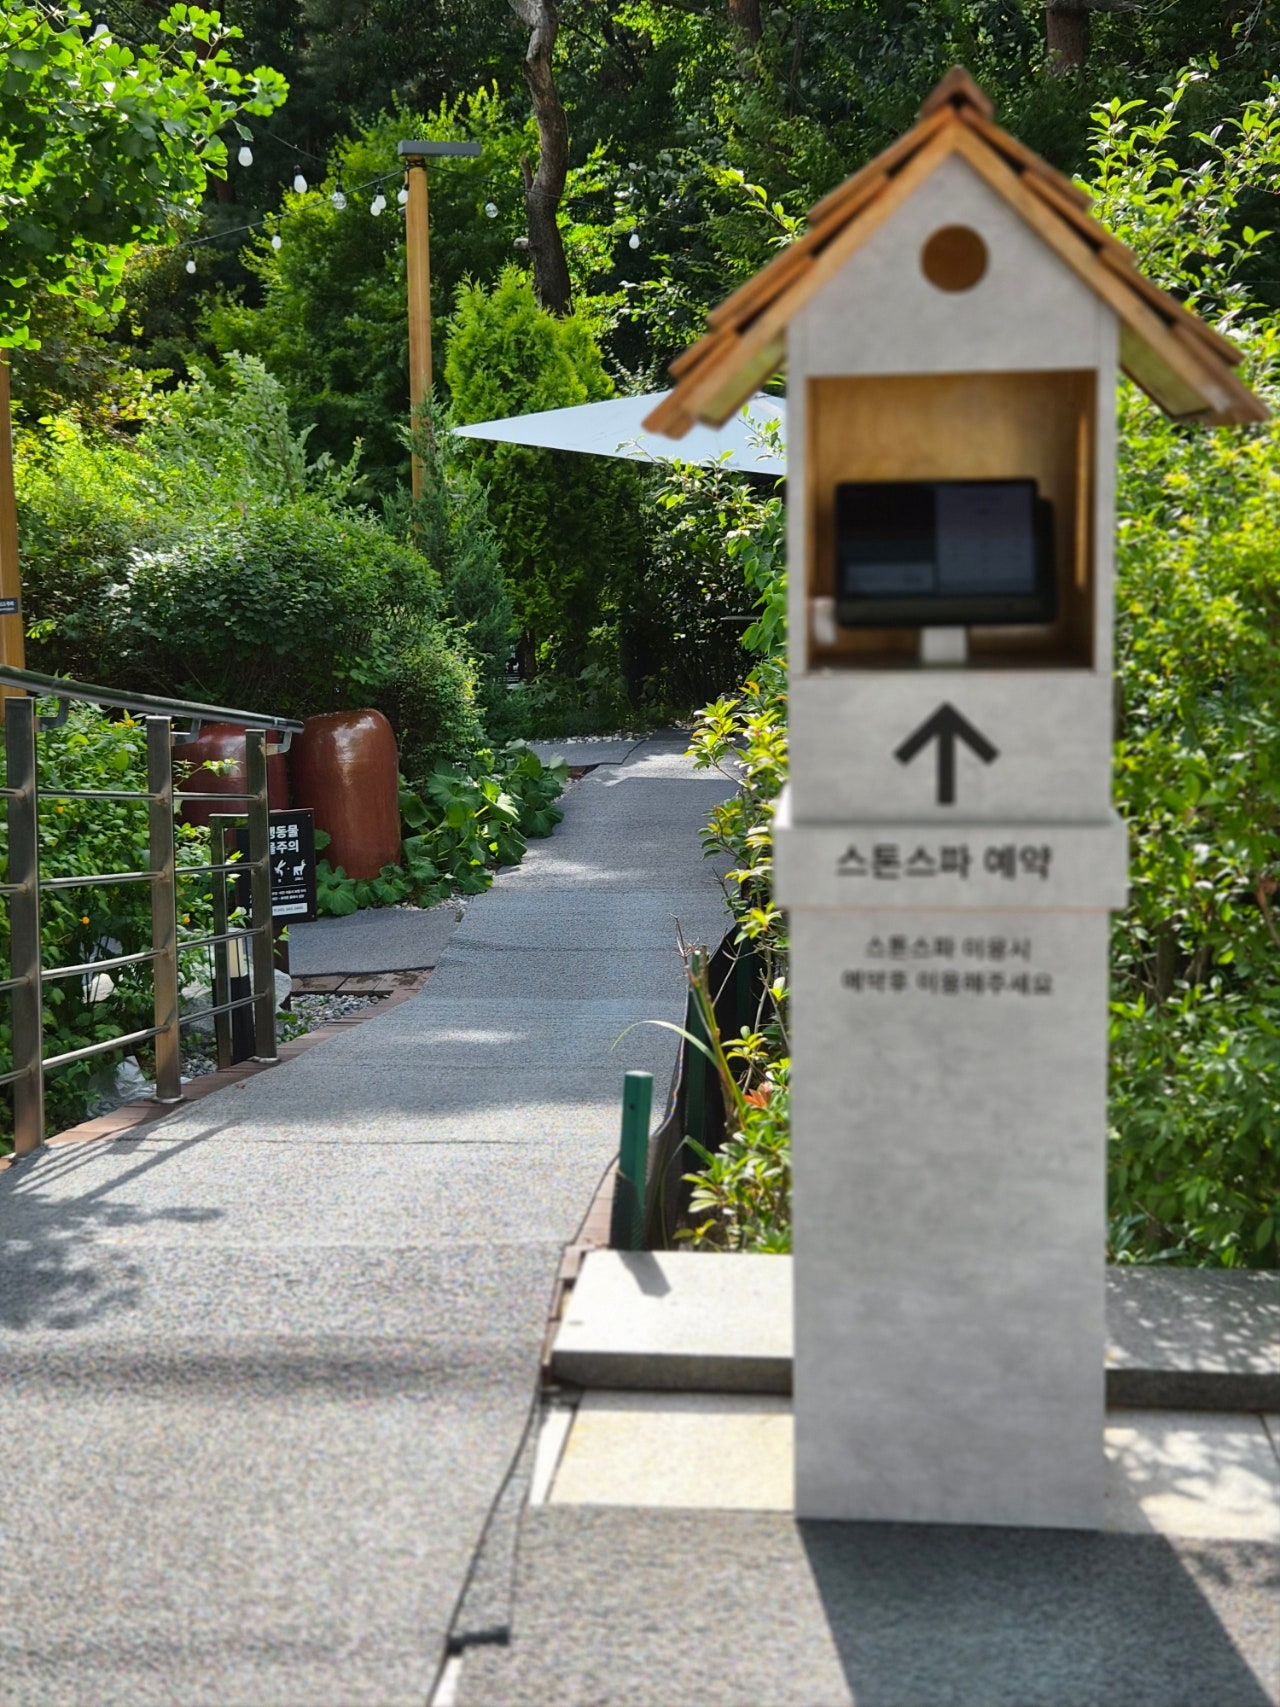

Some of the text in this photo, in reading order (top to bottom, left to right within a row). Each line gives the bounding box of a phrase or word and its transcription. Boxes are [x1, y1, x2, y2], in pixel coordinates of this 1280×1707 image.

[837, 844, 1053, 880] 스톤스파 예약
[865, 936, 1032, 962] 스톤스파 이용시
[917, 972, 1054, 996] 이용해주세요
